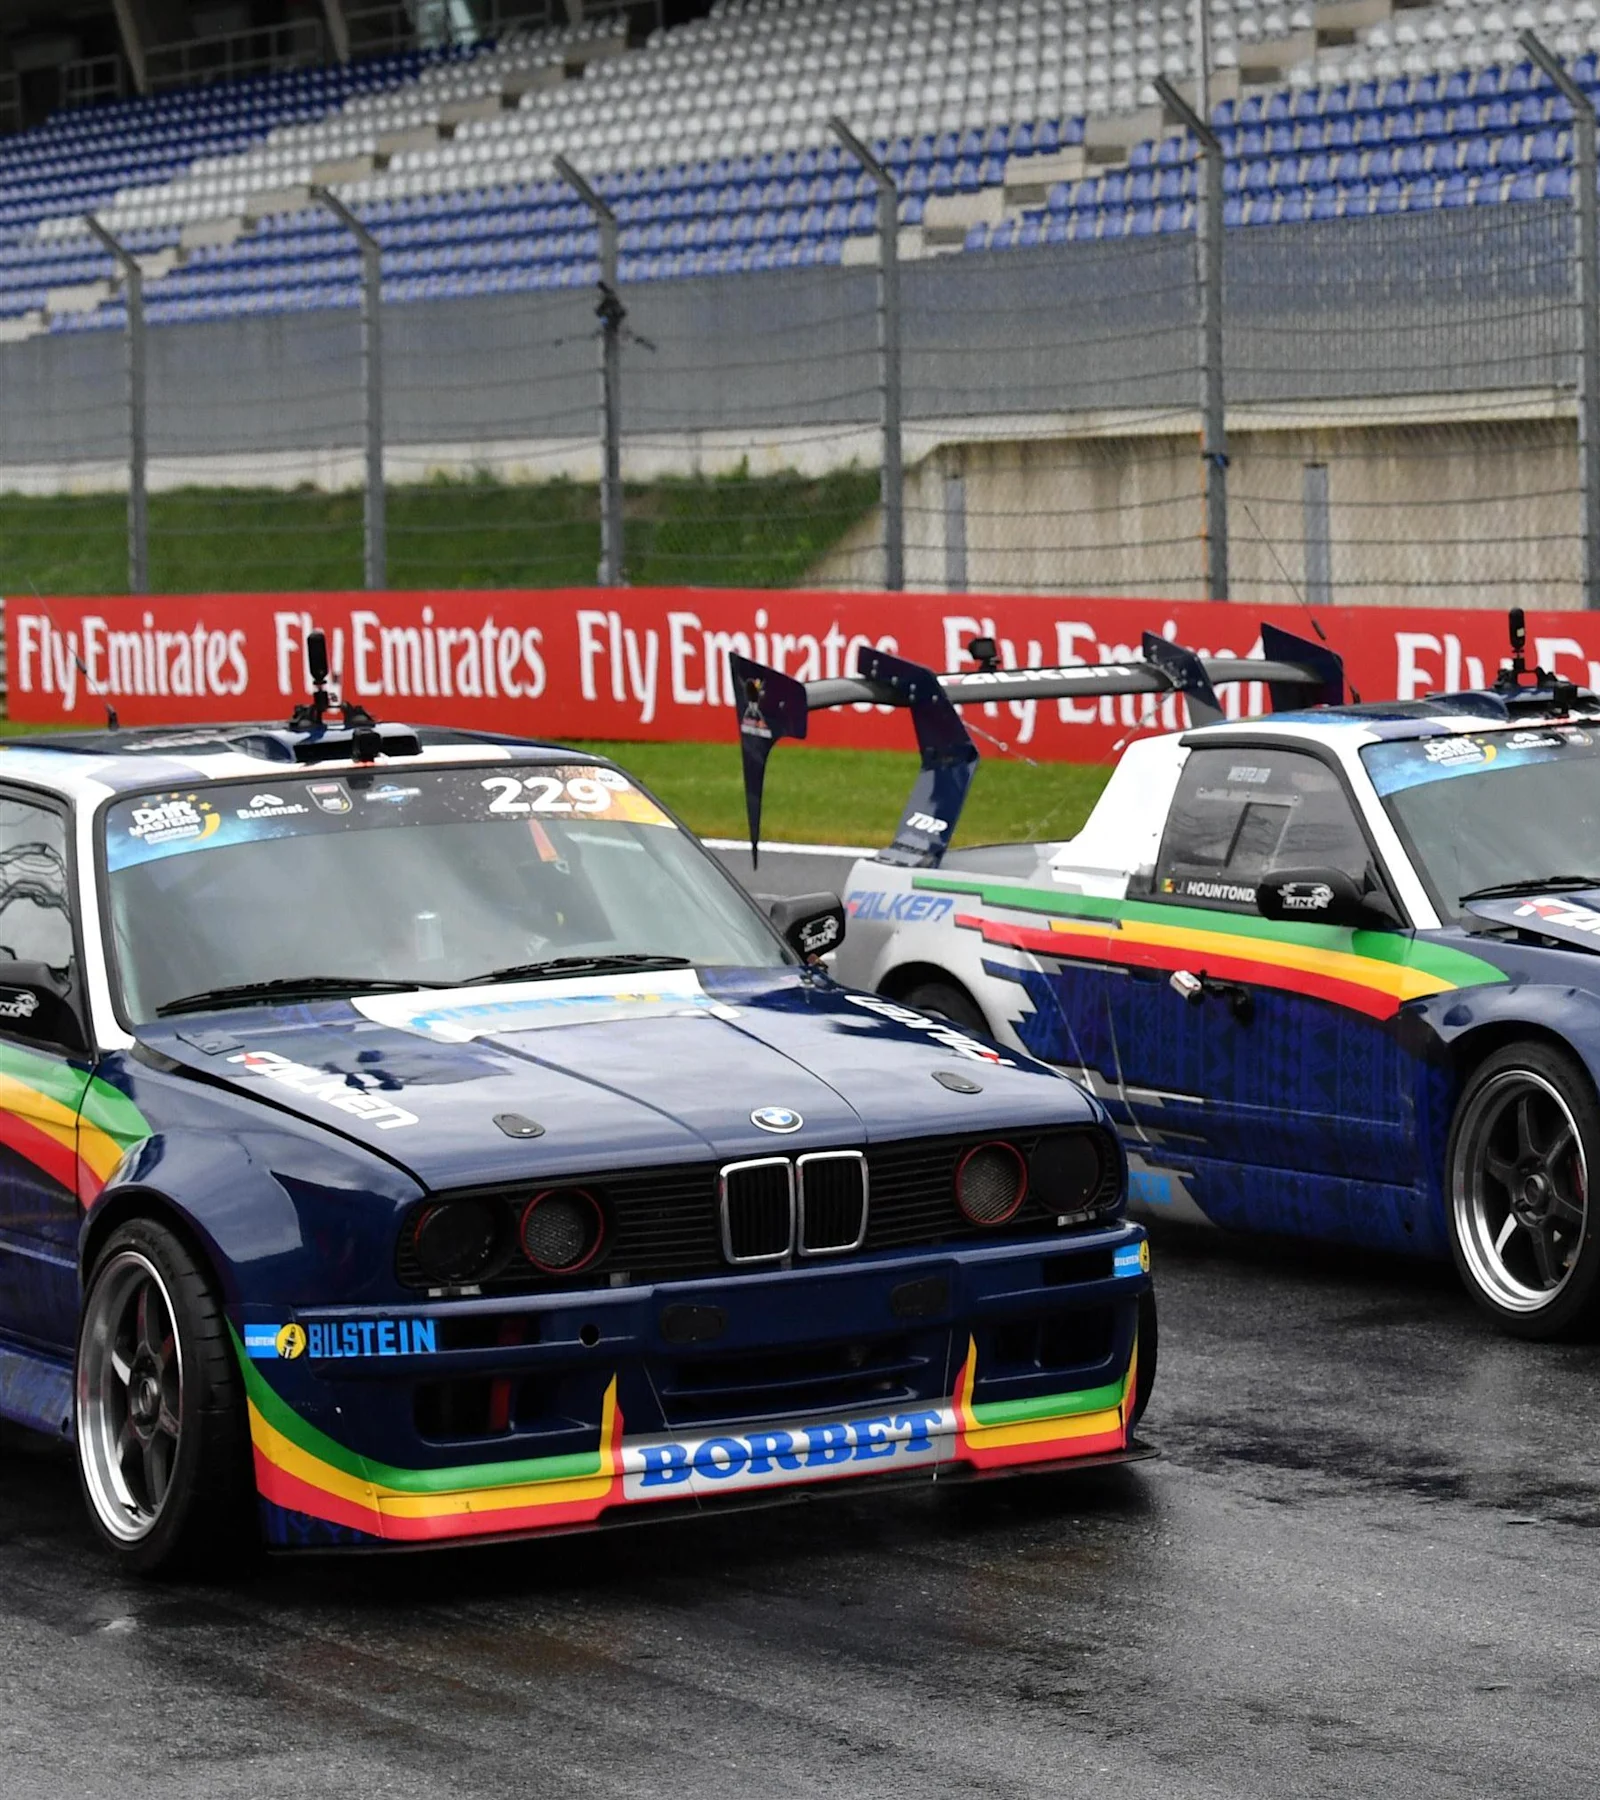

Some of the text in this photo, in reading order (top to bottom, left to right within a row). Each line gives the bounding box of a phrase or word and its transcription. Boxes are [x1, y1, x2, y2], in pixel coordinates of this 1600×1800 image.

[18, 611, 248, 710] Fly Emirates
[351, 606, 547, 698] Emirates
[576, 609, 659, 724] Fly
[936, 665, 1132, 687] FALKEN
[236, 804, 309, 820] Budmat.
[480, 776, 612, 813] 229
[128, 814, 201, 837] MASTERS
[131, 801, 197, 826] Drift
[844, 889, 954, 922] FALKEN
[1187, 880, 1256, 902] HOUNTOND
[226, 1051, 420, 1130] FALKEN
[308, 1319, 437, 1358] BILSTEIN
[639, 1410, 943, 1488] BORBET
